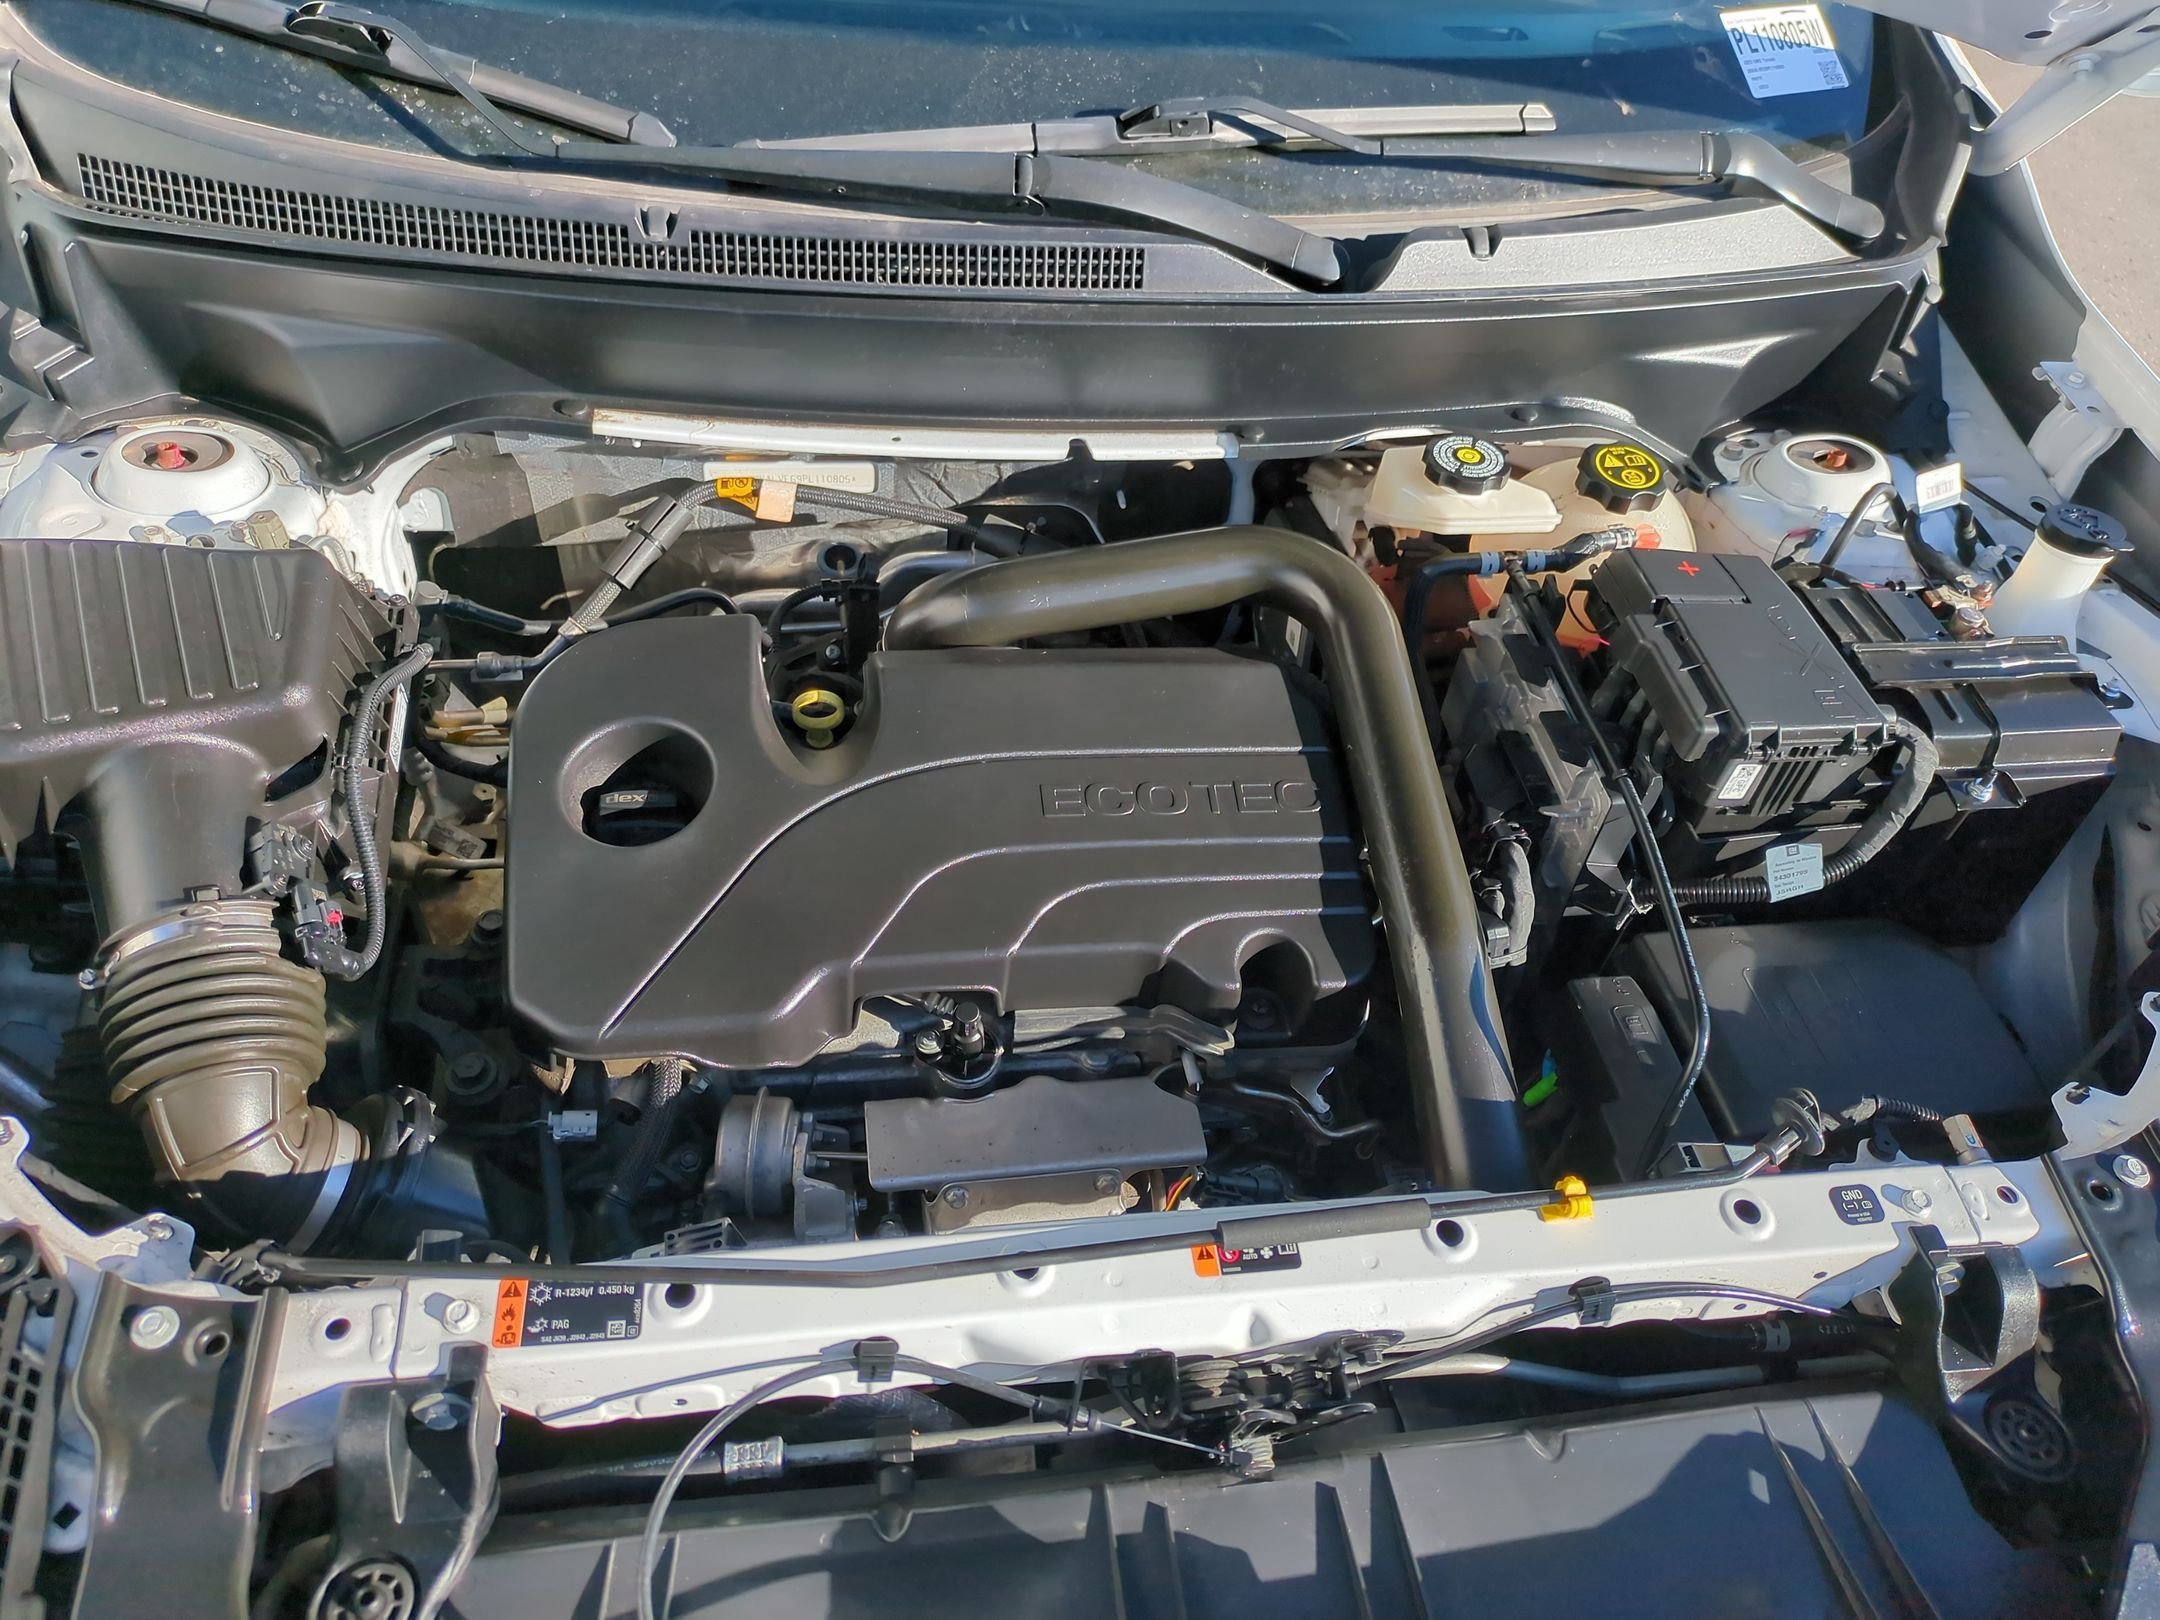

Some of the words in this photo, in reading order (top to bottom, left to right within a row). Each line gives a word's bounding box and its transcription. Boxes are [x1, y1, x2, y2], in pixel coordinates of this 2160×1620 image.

[1730, 19, 1825, 55] PL110805W
[1039, 780, 1322, 816] ECOTEC
[1841, 1190, 1863, 1200] GND
[1243, 1252, 1258, 1260] AUTO
[555, 1287, 594, 1298] R-1234yf
[598, 1286, 621, 1295] 0.450
[623, 1285, 635, 1295] kg
[551, 1319, 570, 1330] PAG
